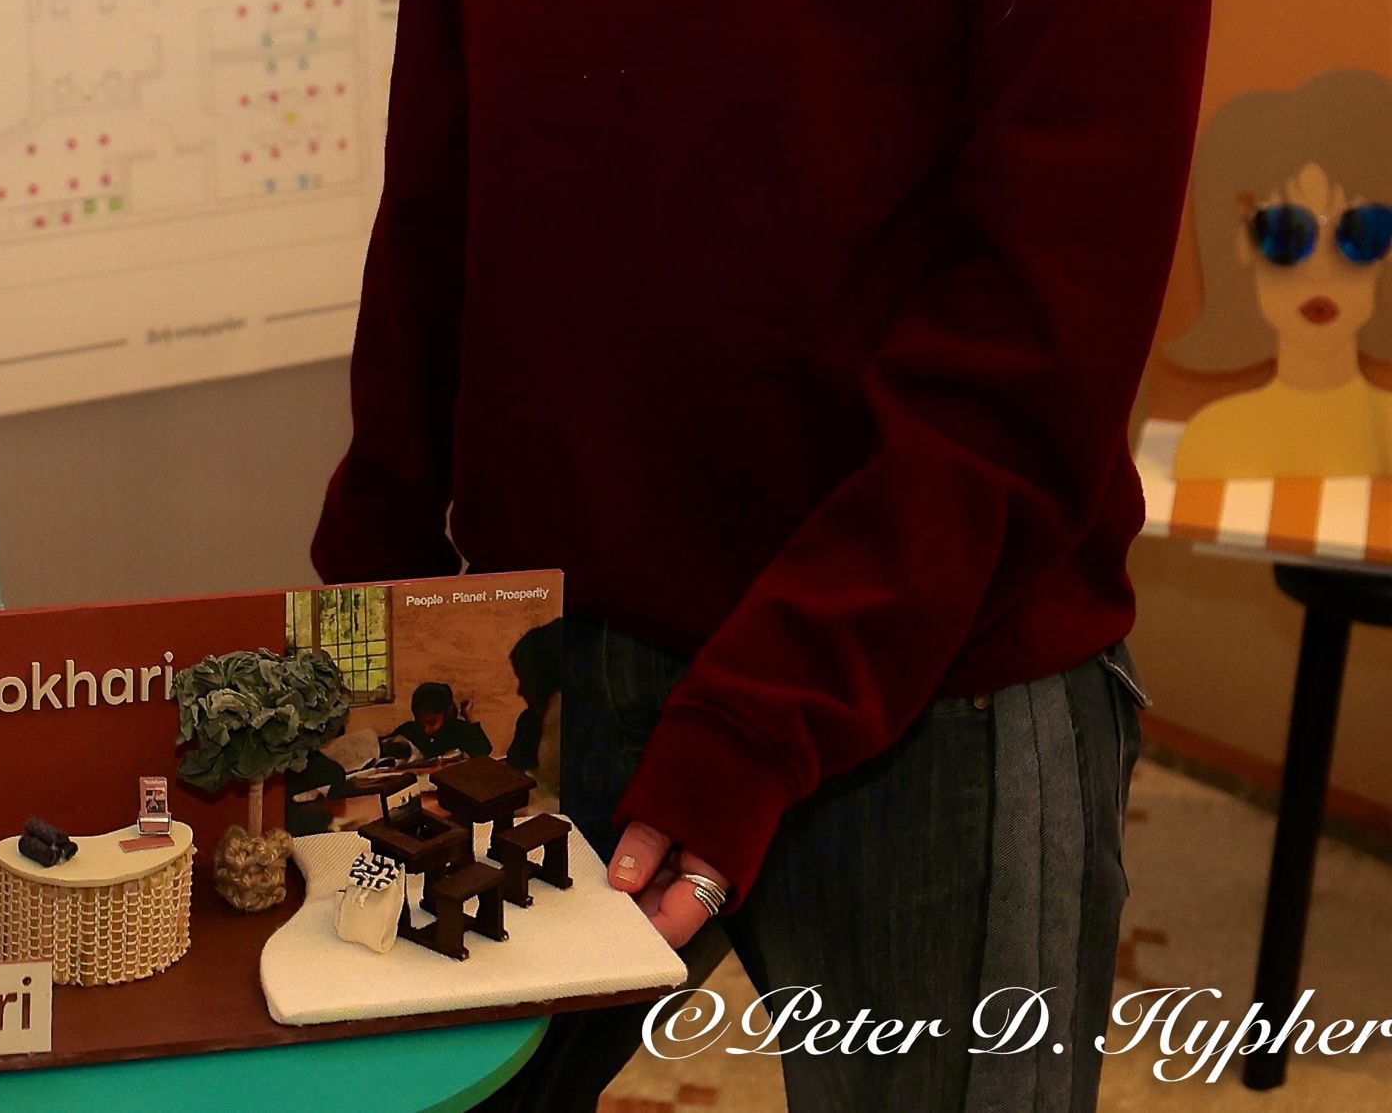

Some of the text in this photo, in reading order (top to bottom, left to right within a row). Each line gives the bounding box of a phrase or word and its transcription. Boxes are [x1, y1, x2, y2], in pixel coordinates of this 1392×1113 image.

[405, 594, 443, 608] People
[452, 591, 486, 604] Planet
[495, 586, 549, 601] Prosperity
